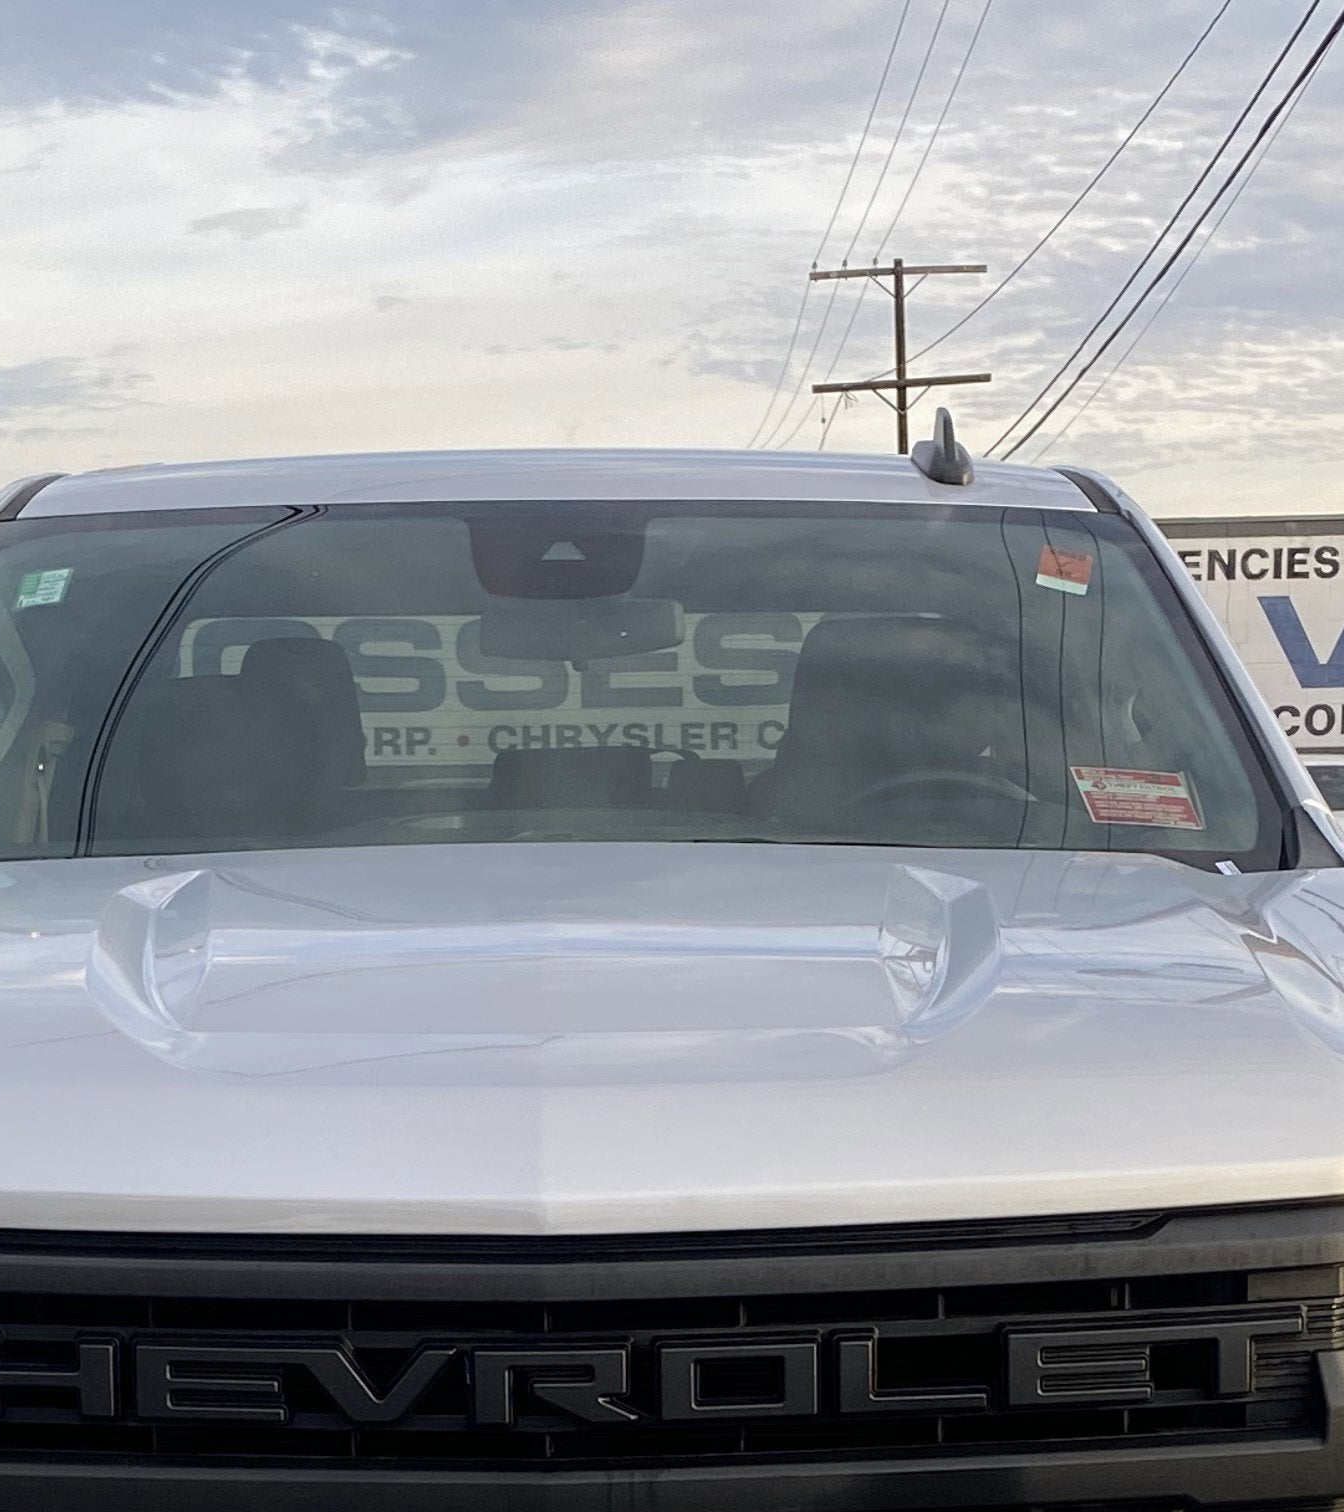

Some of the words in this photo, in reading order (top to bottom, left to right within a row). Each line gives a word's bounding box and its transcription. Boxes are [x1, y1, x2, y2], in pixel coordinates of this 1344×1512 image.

[1177, 546, 1340, 581] ENCIES
[364, 726, 437, 756] RP.
[487, 721, 740, 751] CHRYSLER
